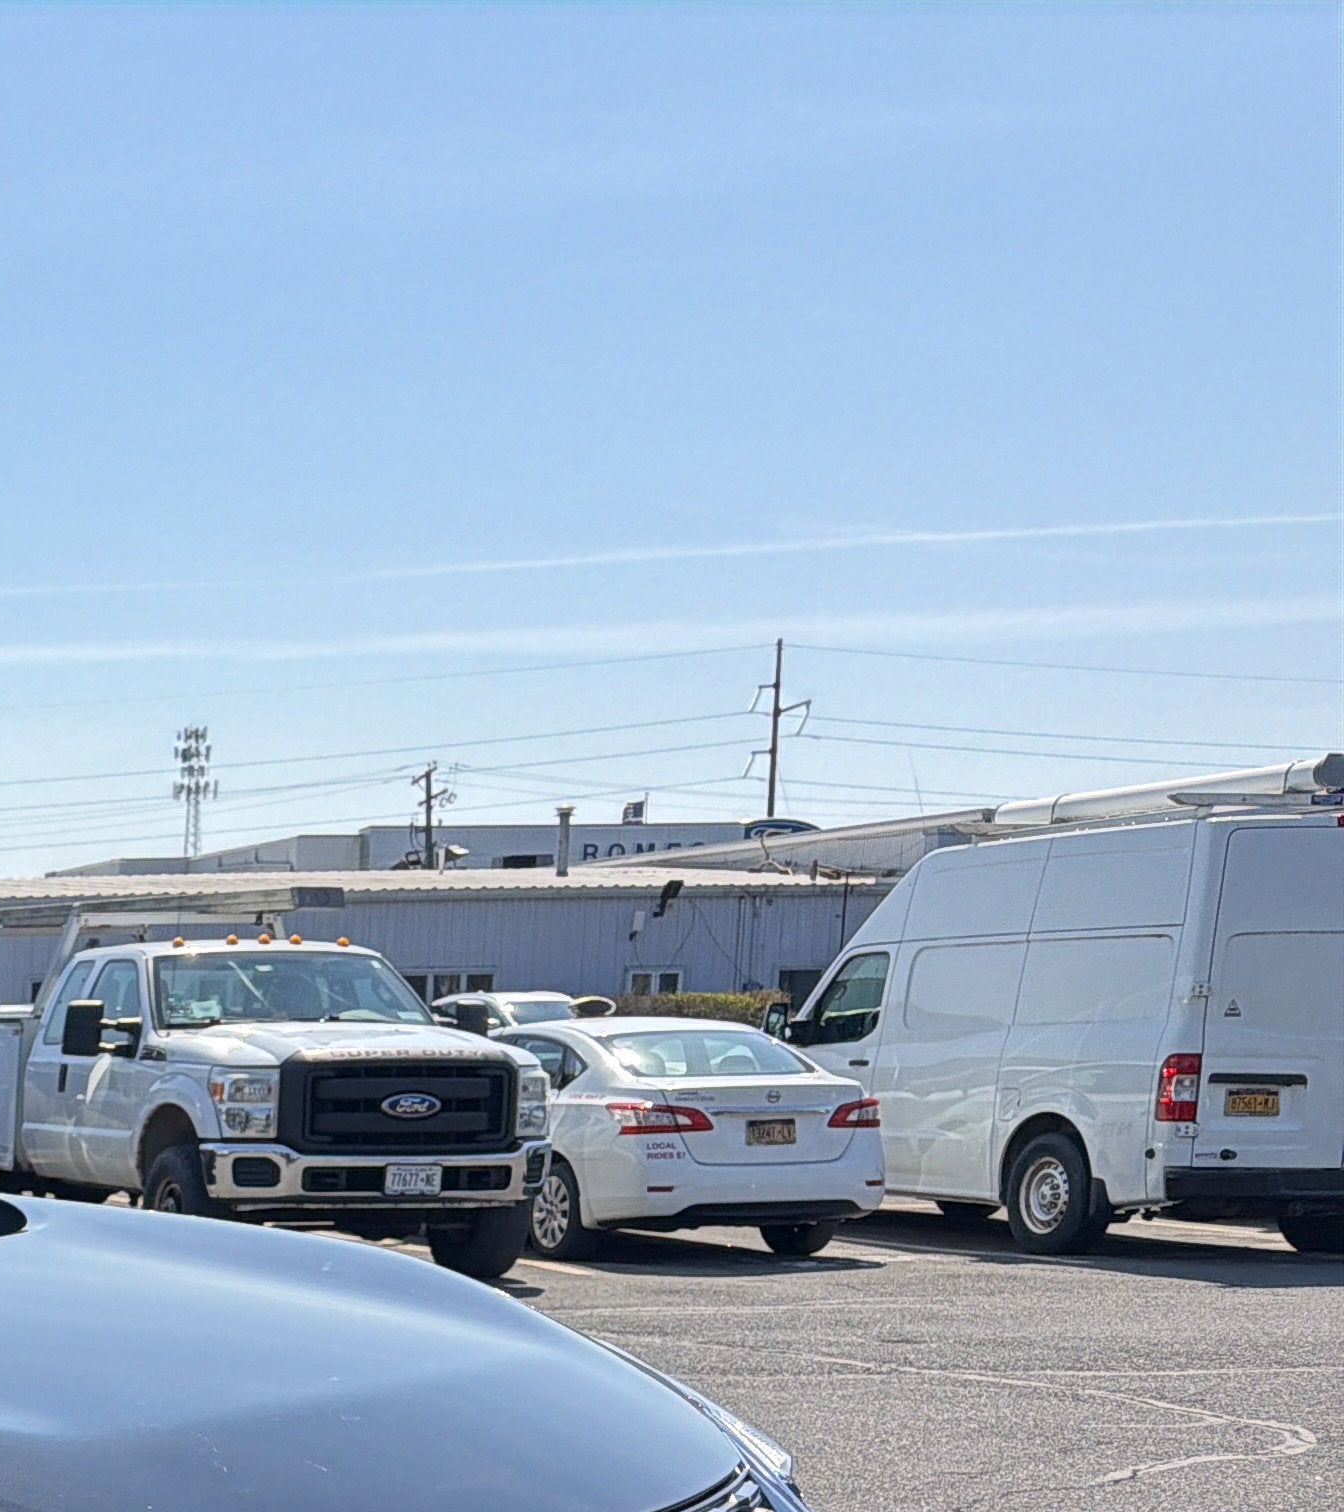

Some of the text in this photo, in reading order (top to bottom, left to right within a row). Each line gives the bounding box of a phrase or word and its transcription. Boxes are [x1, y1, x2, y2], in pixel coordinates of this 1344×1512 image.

[582, 842, 705, 861] ROM
[330, 1049, 481, 1058] SUPER DUTY
[395, 1097, 430, 1113] Ford
[646, 1142, 676, 1150] LOCAL
[647, 1152, 674, 1160] RIDES
